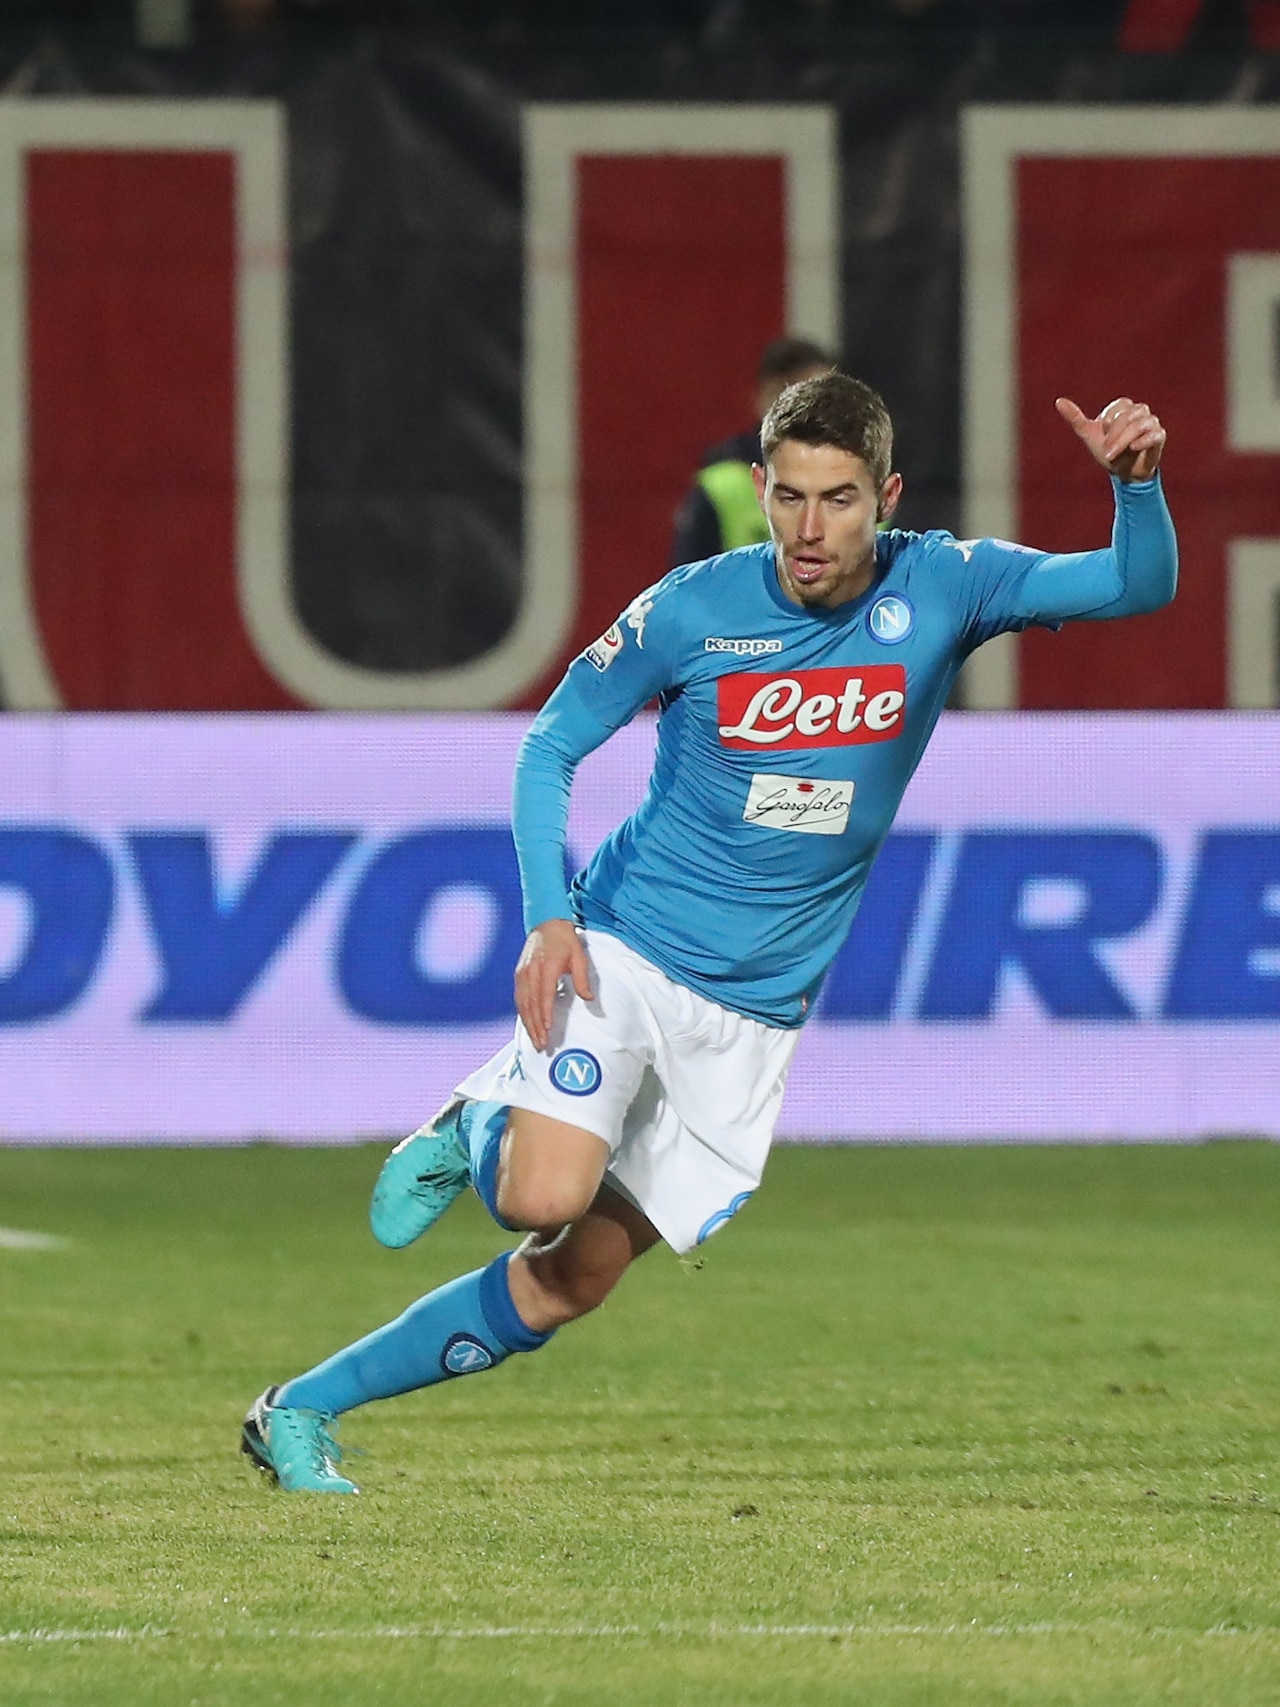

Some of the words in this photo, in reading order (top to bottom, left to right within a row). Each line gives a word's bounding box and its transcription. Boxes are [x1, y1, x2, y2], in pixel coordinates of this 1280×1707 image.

[877, 605, 901, 631] N
[705, 638, 782, 655] Kappa
[718, 678, 904, 744] Lete
[744, 788, 850, 828] Garofalo
[562, 1058, 591, 1086] N
